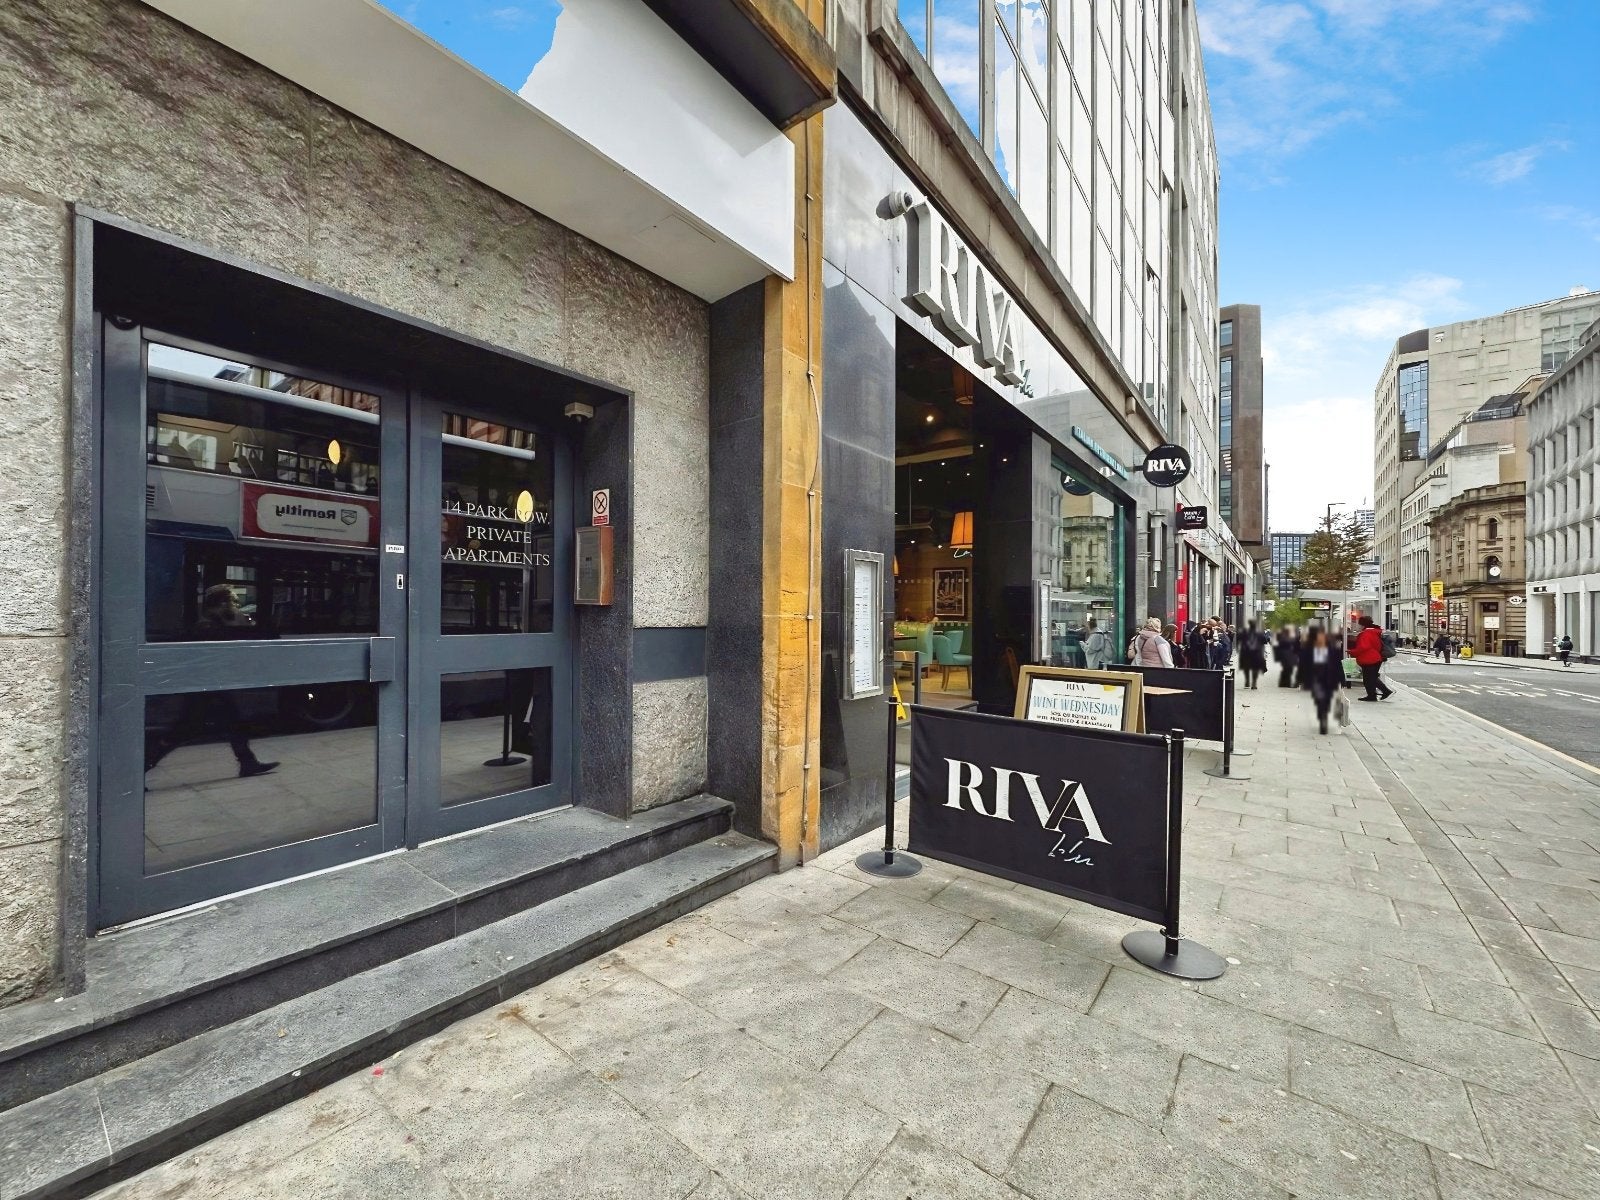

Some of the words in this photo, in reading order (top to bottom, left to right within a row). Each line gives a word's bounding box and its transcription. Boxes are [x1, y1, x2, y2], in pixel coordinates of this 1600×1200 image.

[903, 197, 1024, 386] RIVA
[1147, 458, 1186, 473] RIVA
[445, 500, 463, 515] 14
[466, 502, 509, 520] PARK
[466, 525, 532, 544] PRIVATE
[443, 547, 550, 566] APARTMENTS
[1066, 683, 1086, 692] RIVA
[1033, 695, 1057, 709] WINE
[1061, 698, 1121, 716] WEDNESDAY
[941, 757, 1113, 846] RIVA
